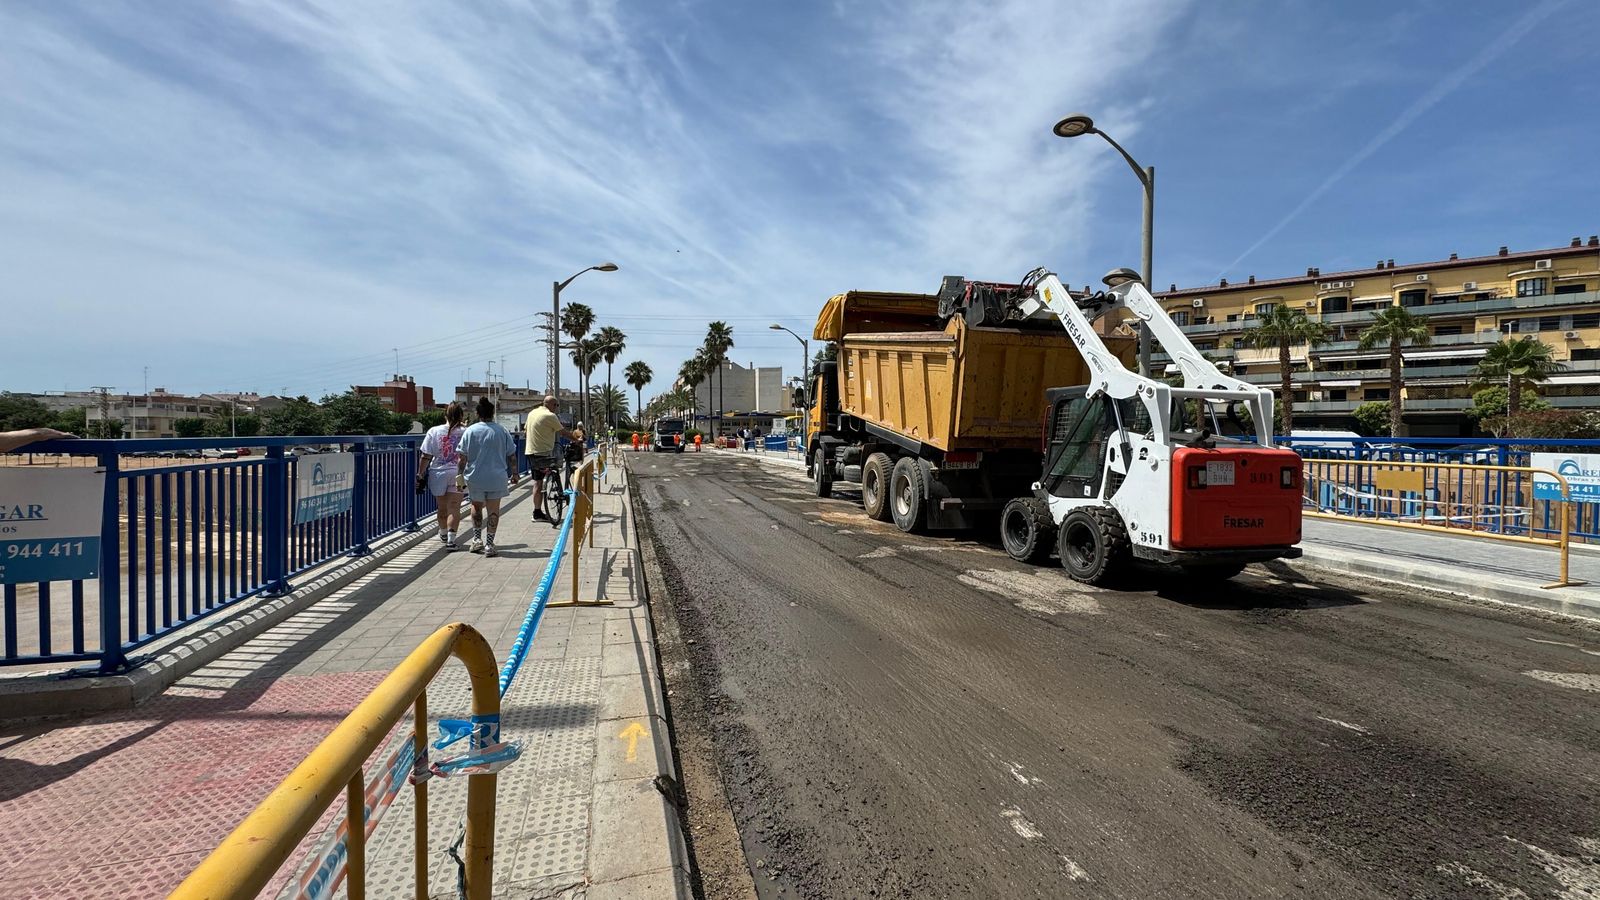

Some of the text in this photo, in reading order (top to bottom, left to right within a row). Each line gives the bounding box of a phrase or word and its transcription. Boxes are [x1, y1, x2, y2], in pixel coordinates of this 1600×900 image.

[1062, 313, 1086, 348] FRESAR
[1208, 463, 1233, 472] E 1832
[1223, 518, 1264, 528] FRESAR
[1140, 531, 1163, 546] 591
[8, 541, 83, 559] 944 411
